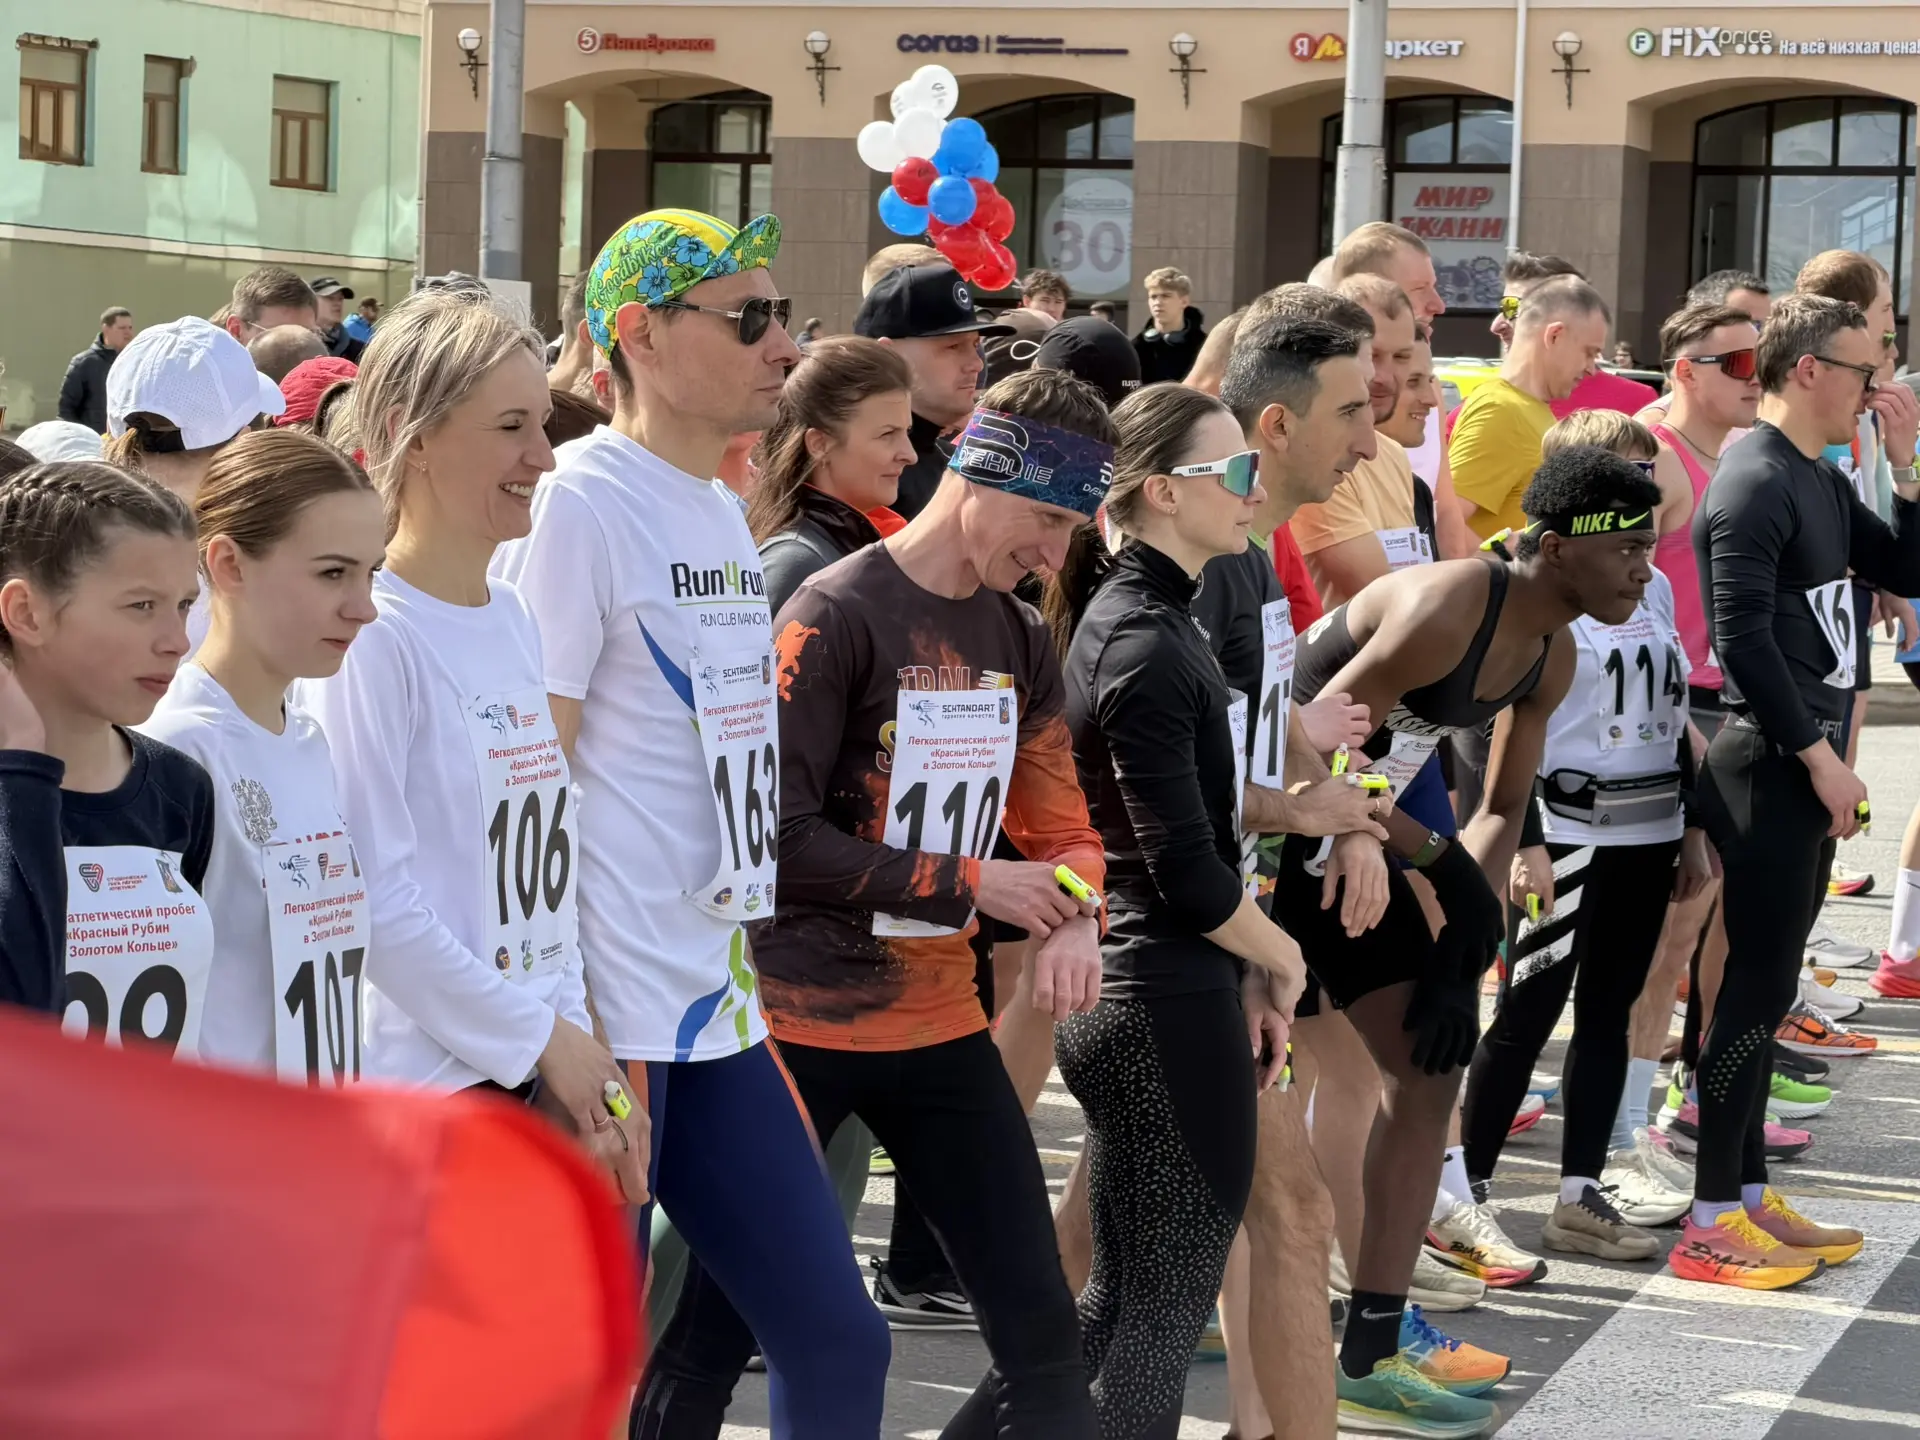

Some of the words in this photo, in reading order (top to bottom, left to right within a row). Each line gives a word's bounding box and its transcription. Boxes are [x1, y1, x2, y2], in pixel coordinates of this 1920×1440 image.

[1719, 29, 1773, 47] price
[1780, 40, 1797, 55] На
[1801, 38, 1825, 55] всё
[1828, 41, 1880, 55] низкая
[1414, 186, 1491, 209] МИР
[1400, 216, 1505, 240] ТКАНИ
[1053, 221, 1125, 272] 30
[1571, 511, 1615, 535] NIKE
[700, 613, 717, 628] RUN
[718, 612, 736, 627] CLUB
[723, 663, 760, 678] SCHTANDART
[1604, 643, 1686, 716] 114
[942, 703, 996, 713] SCHTANDART
[718, 734, 723, 742] в
[907, 735, 988, 746] Легкоатлетический
[989, 734, 1010, 746] пробег
[930, 747, 970, 760] «Красный
[923, 762, 929, 770] в
[931, 760, 967, 770] Золотом
[505, 778, 510, 787] в
[512, 772, 539, 786] Золотом
[713, 742, 778, 872] 163
[895, 776, 1000, 862] 110
[488, 786, 570, 926] 106
[67, 906, 152, 924] атлетический
[156, 904, 196, 918] пробег
[66, 923, 129, 942] «Красный
[132, 922, 170, 938] Рубин
[303, 934, 309, 944] в
[69, 943, 123, 958] Золотом
[126, 940, 178, 954] Кольце»
[284, 947, 365, 1089] 107
